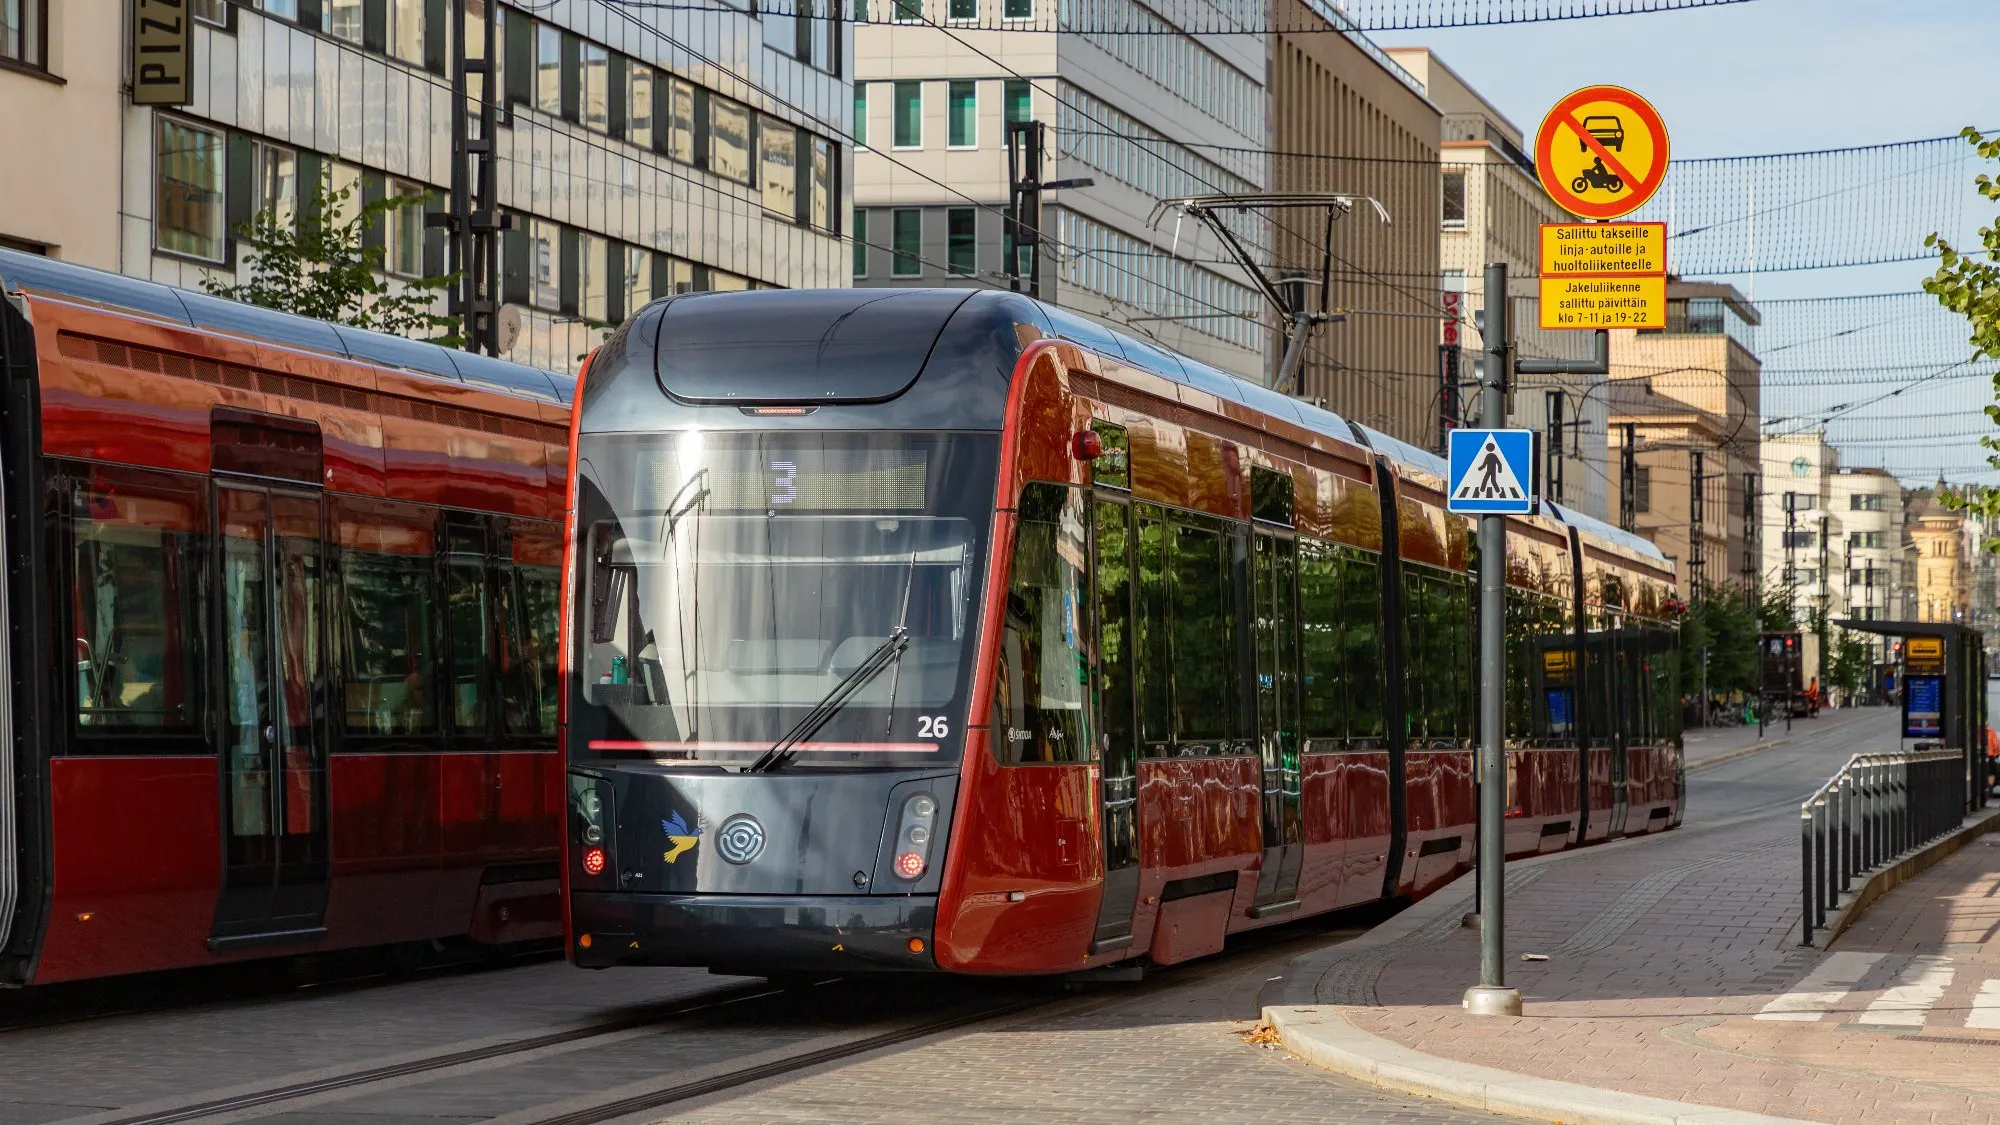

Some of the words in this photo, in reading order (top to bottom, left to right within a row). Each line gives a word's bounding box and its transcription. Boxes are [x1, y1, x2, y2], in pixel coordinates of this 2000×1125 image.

[1557, 228, 1597, 240] Sallittu
[1601, 227, 1649, 239] takseille
[1560, 244, 1632, 257] linja-autoille
[1635, 243, 1646, 256] ja
[1553, 259, 1652, 271] huoltoliikenteelle
[1565, 282, 1641, 293] Jakeluliikenne
[1559, 298, 1595, 309] sallittu
[1598, 298, 1647, 310] päivittäin
[1558, 313, 1574, 323] klo
[1577, 313, 1598, 323] 7-11
[1601, 313, 1612, 324] ja
[1615, 312, 1647, 323] 19-22
[771, 461, 797, 504] 3
[917, 715, 949, 738] 26
